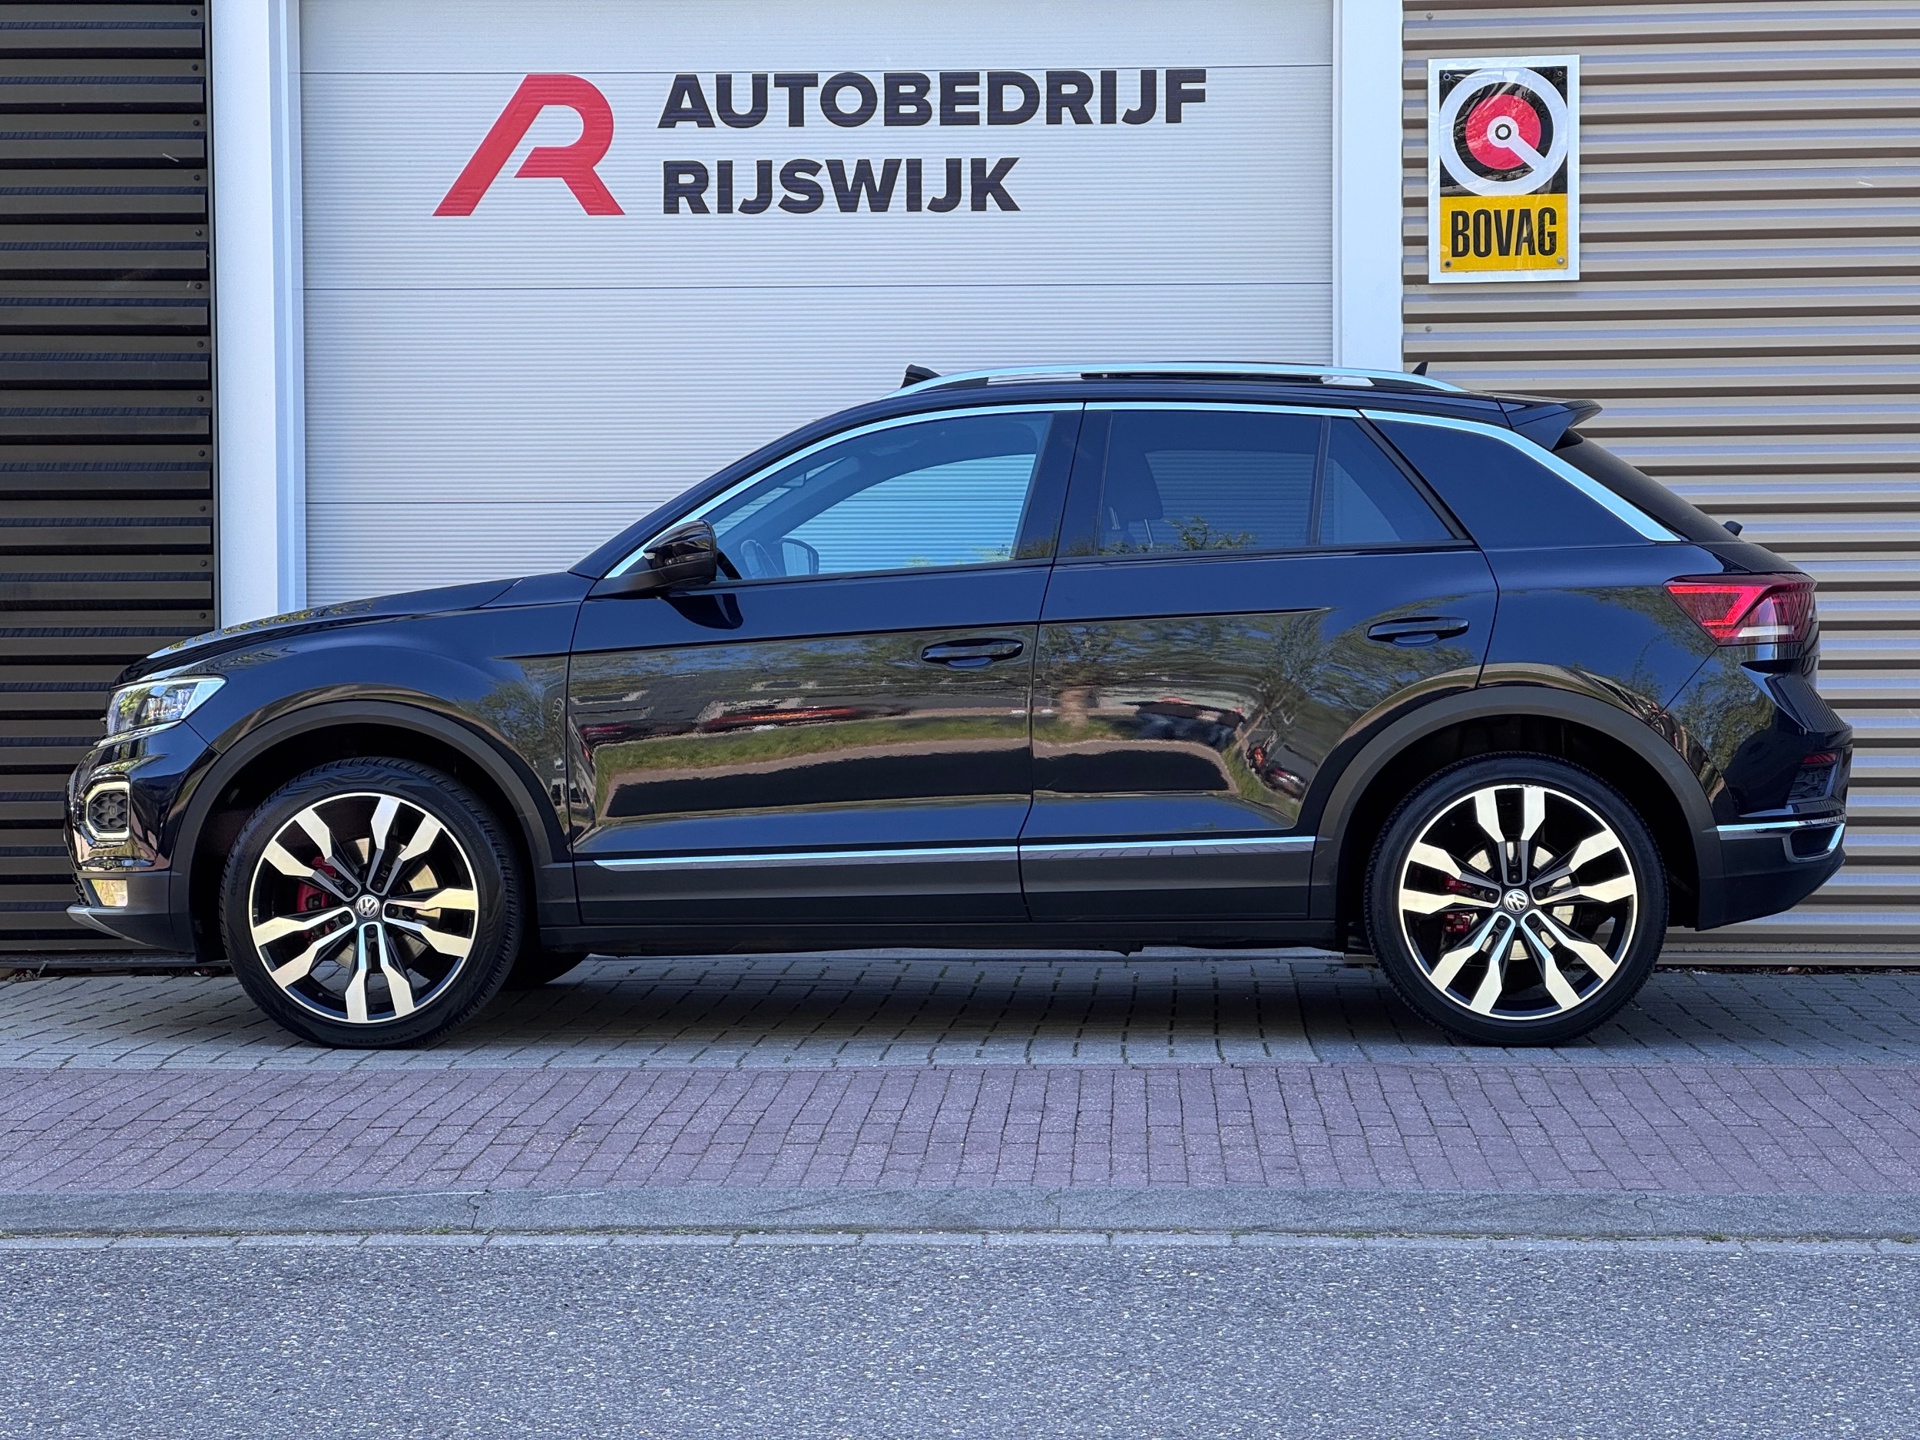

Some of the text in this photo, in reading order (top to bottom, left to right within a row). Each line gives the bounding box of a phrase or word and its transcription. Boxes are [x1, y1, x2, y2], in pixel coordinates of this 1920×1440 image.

[658, 68, 1207, 129] AUTOBEDRIJF
[663, 157, 1021, 215] RIJSWIJK
[1451, 207, 1557, 258] BOVAG
